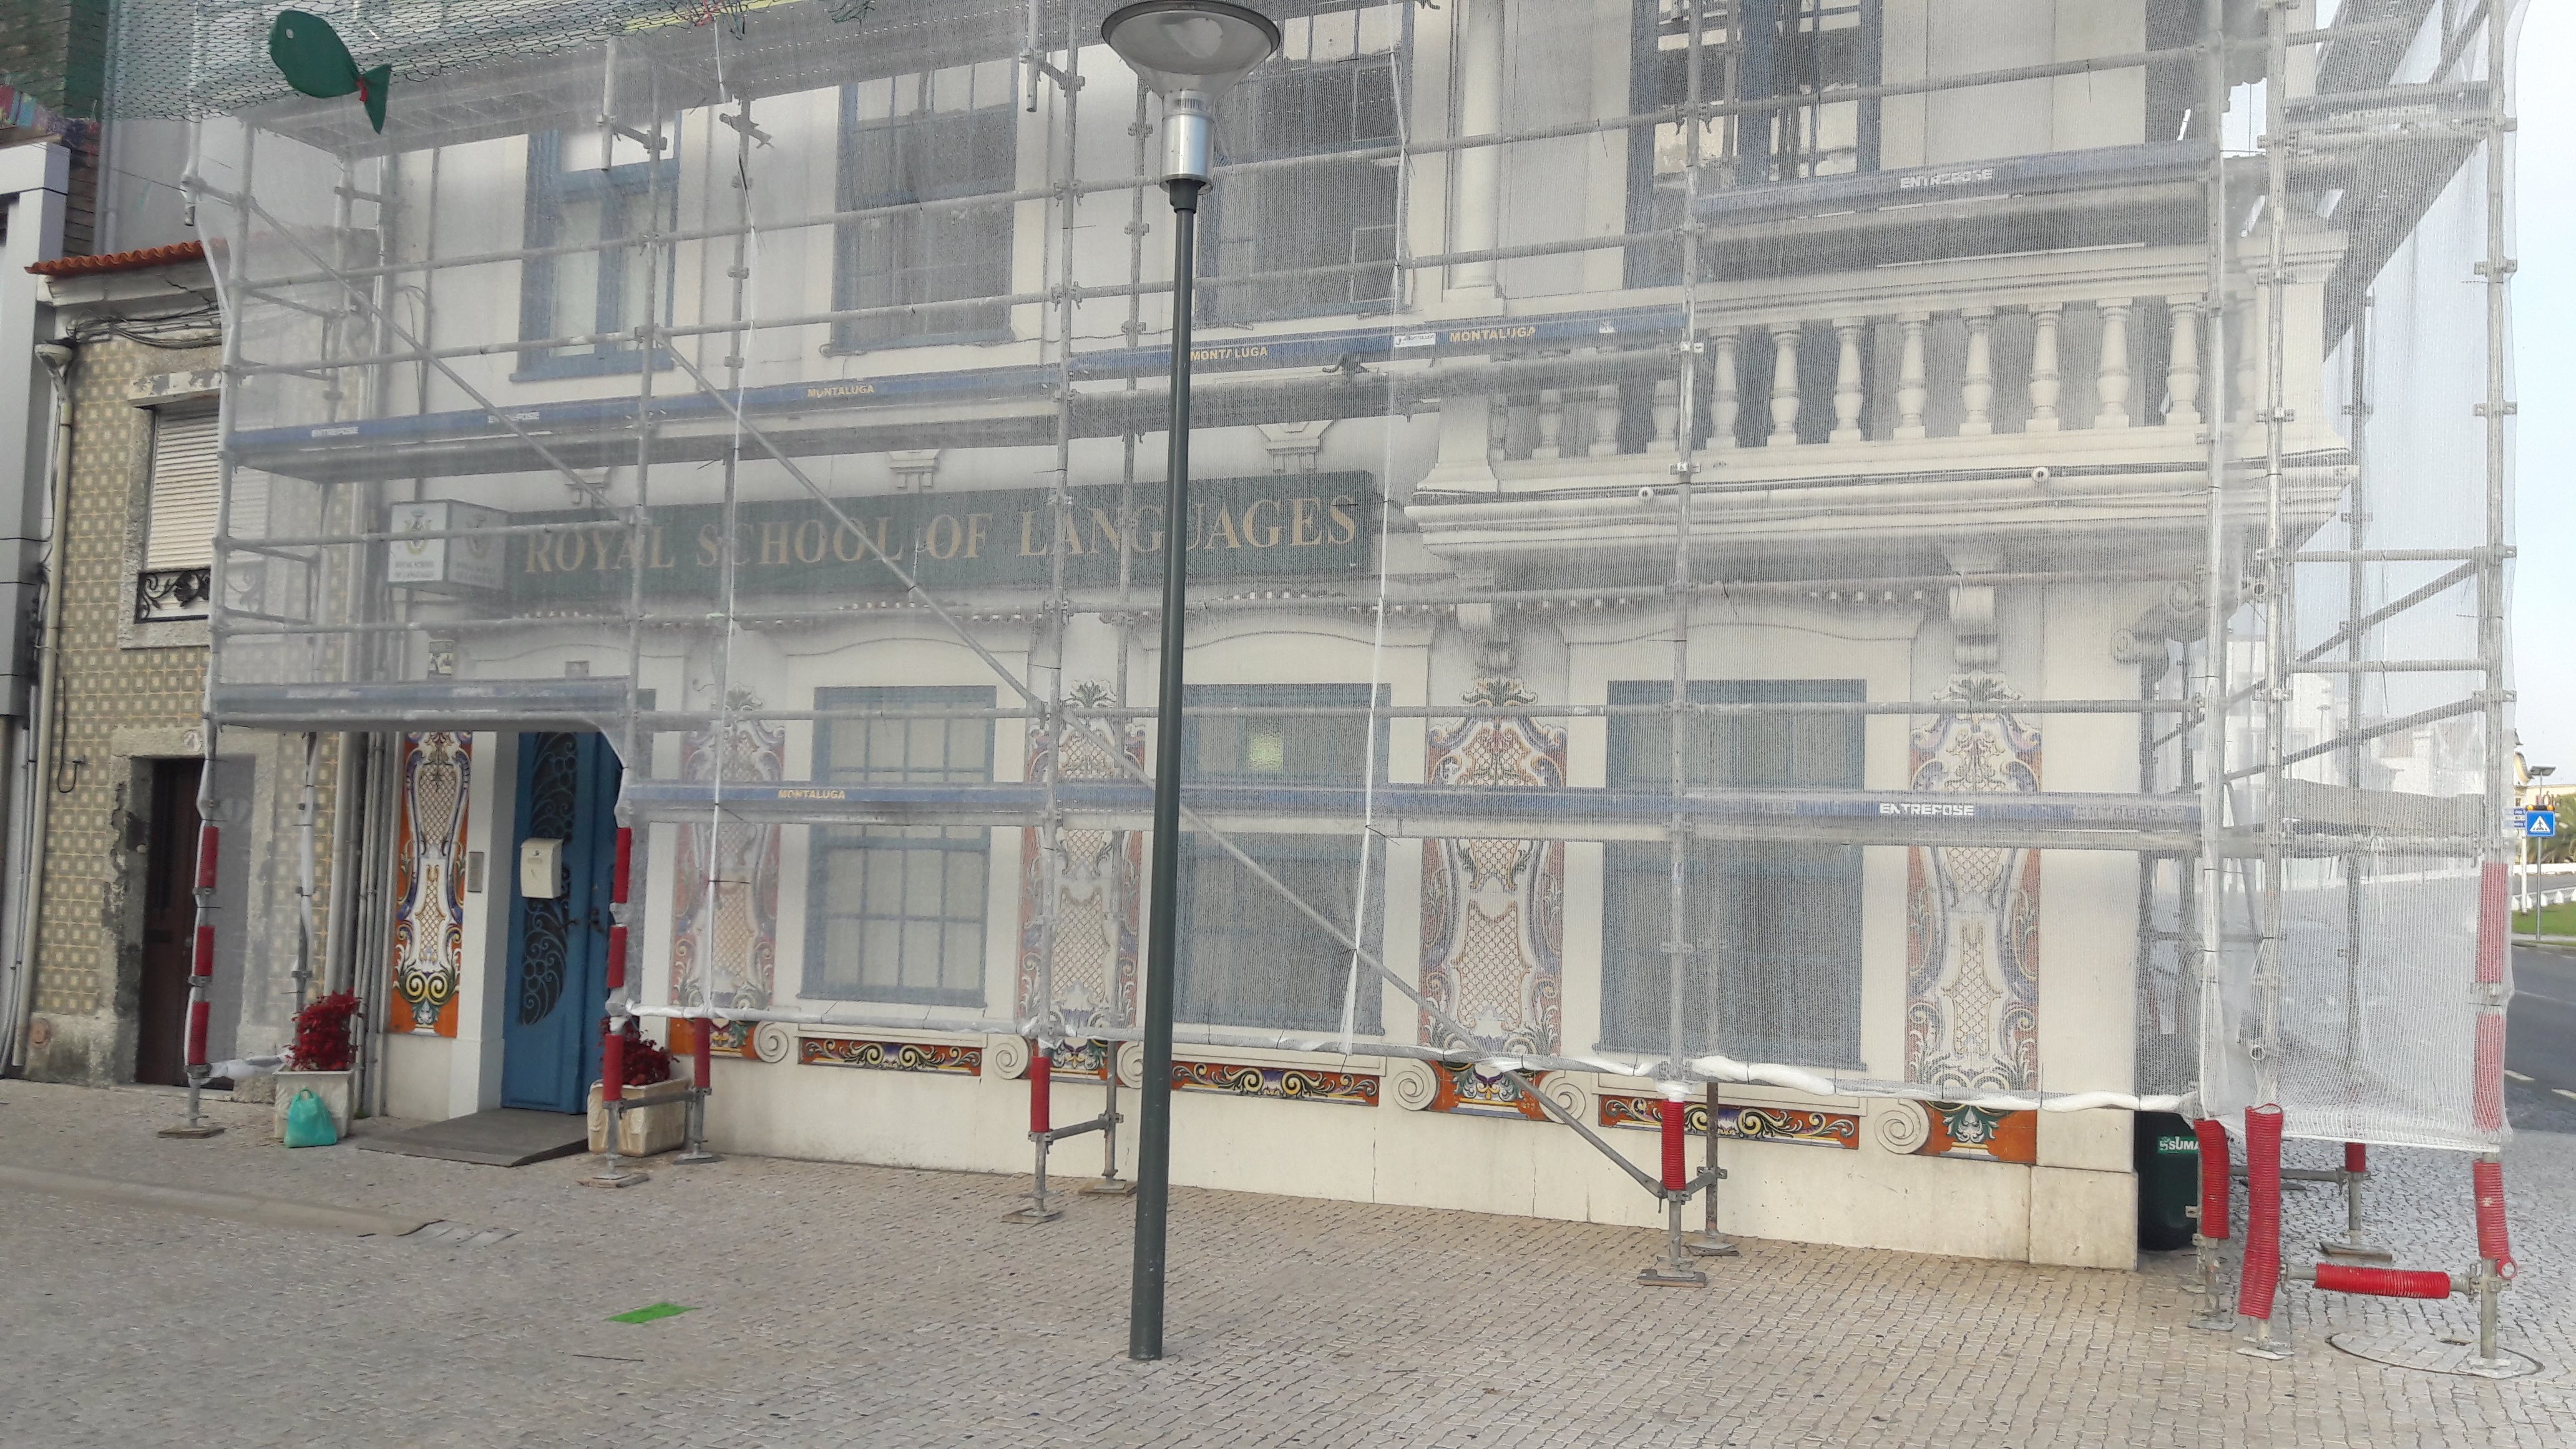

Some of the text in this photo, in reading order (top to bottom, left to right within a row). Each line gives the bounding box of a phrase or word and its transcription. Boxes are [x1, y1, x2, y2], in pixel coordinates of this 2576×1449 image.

[1450, 326, 1536, 343] MONTALUGA
[1190, 346, 1268, 362] MONTALUGA
[807, 384, 874, 398] MONTALUGA
[525, 525, 675, 572] ROYAL
[696, 517, 904, 567] SCHOOL
[927, 513, 993, 559] OF
[778, 789, 846, 799] MONTALUGA
